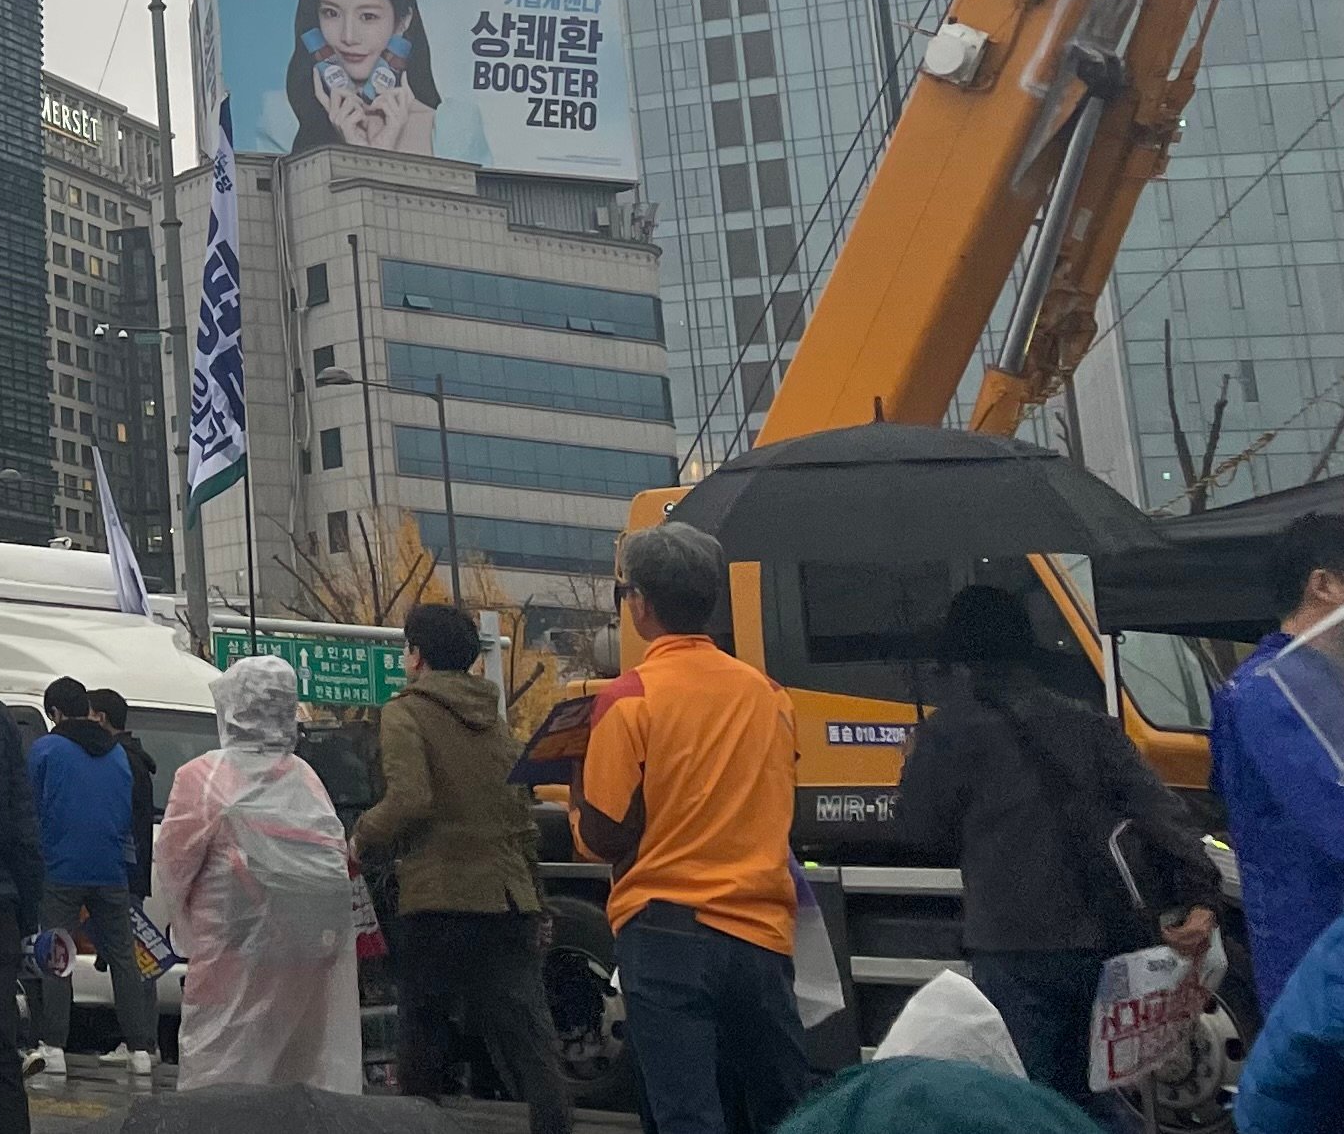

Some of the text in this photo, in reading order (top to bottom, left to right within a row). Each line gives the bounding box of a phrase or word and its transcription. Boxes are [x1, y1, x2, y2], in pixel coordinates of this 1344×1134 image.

[471, 11, 603, 66] 상쾌환
[473, 61, 599, 98] BOOSTER
[526, 97, 597, 131] ZERO
